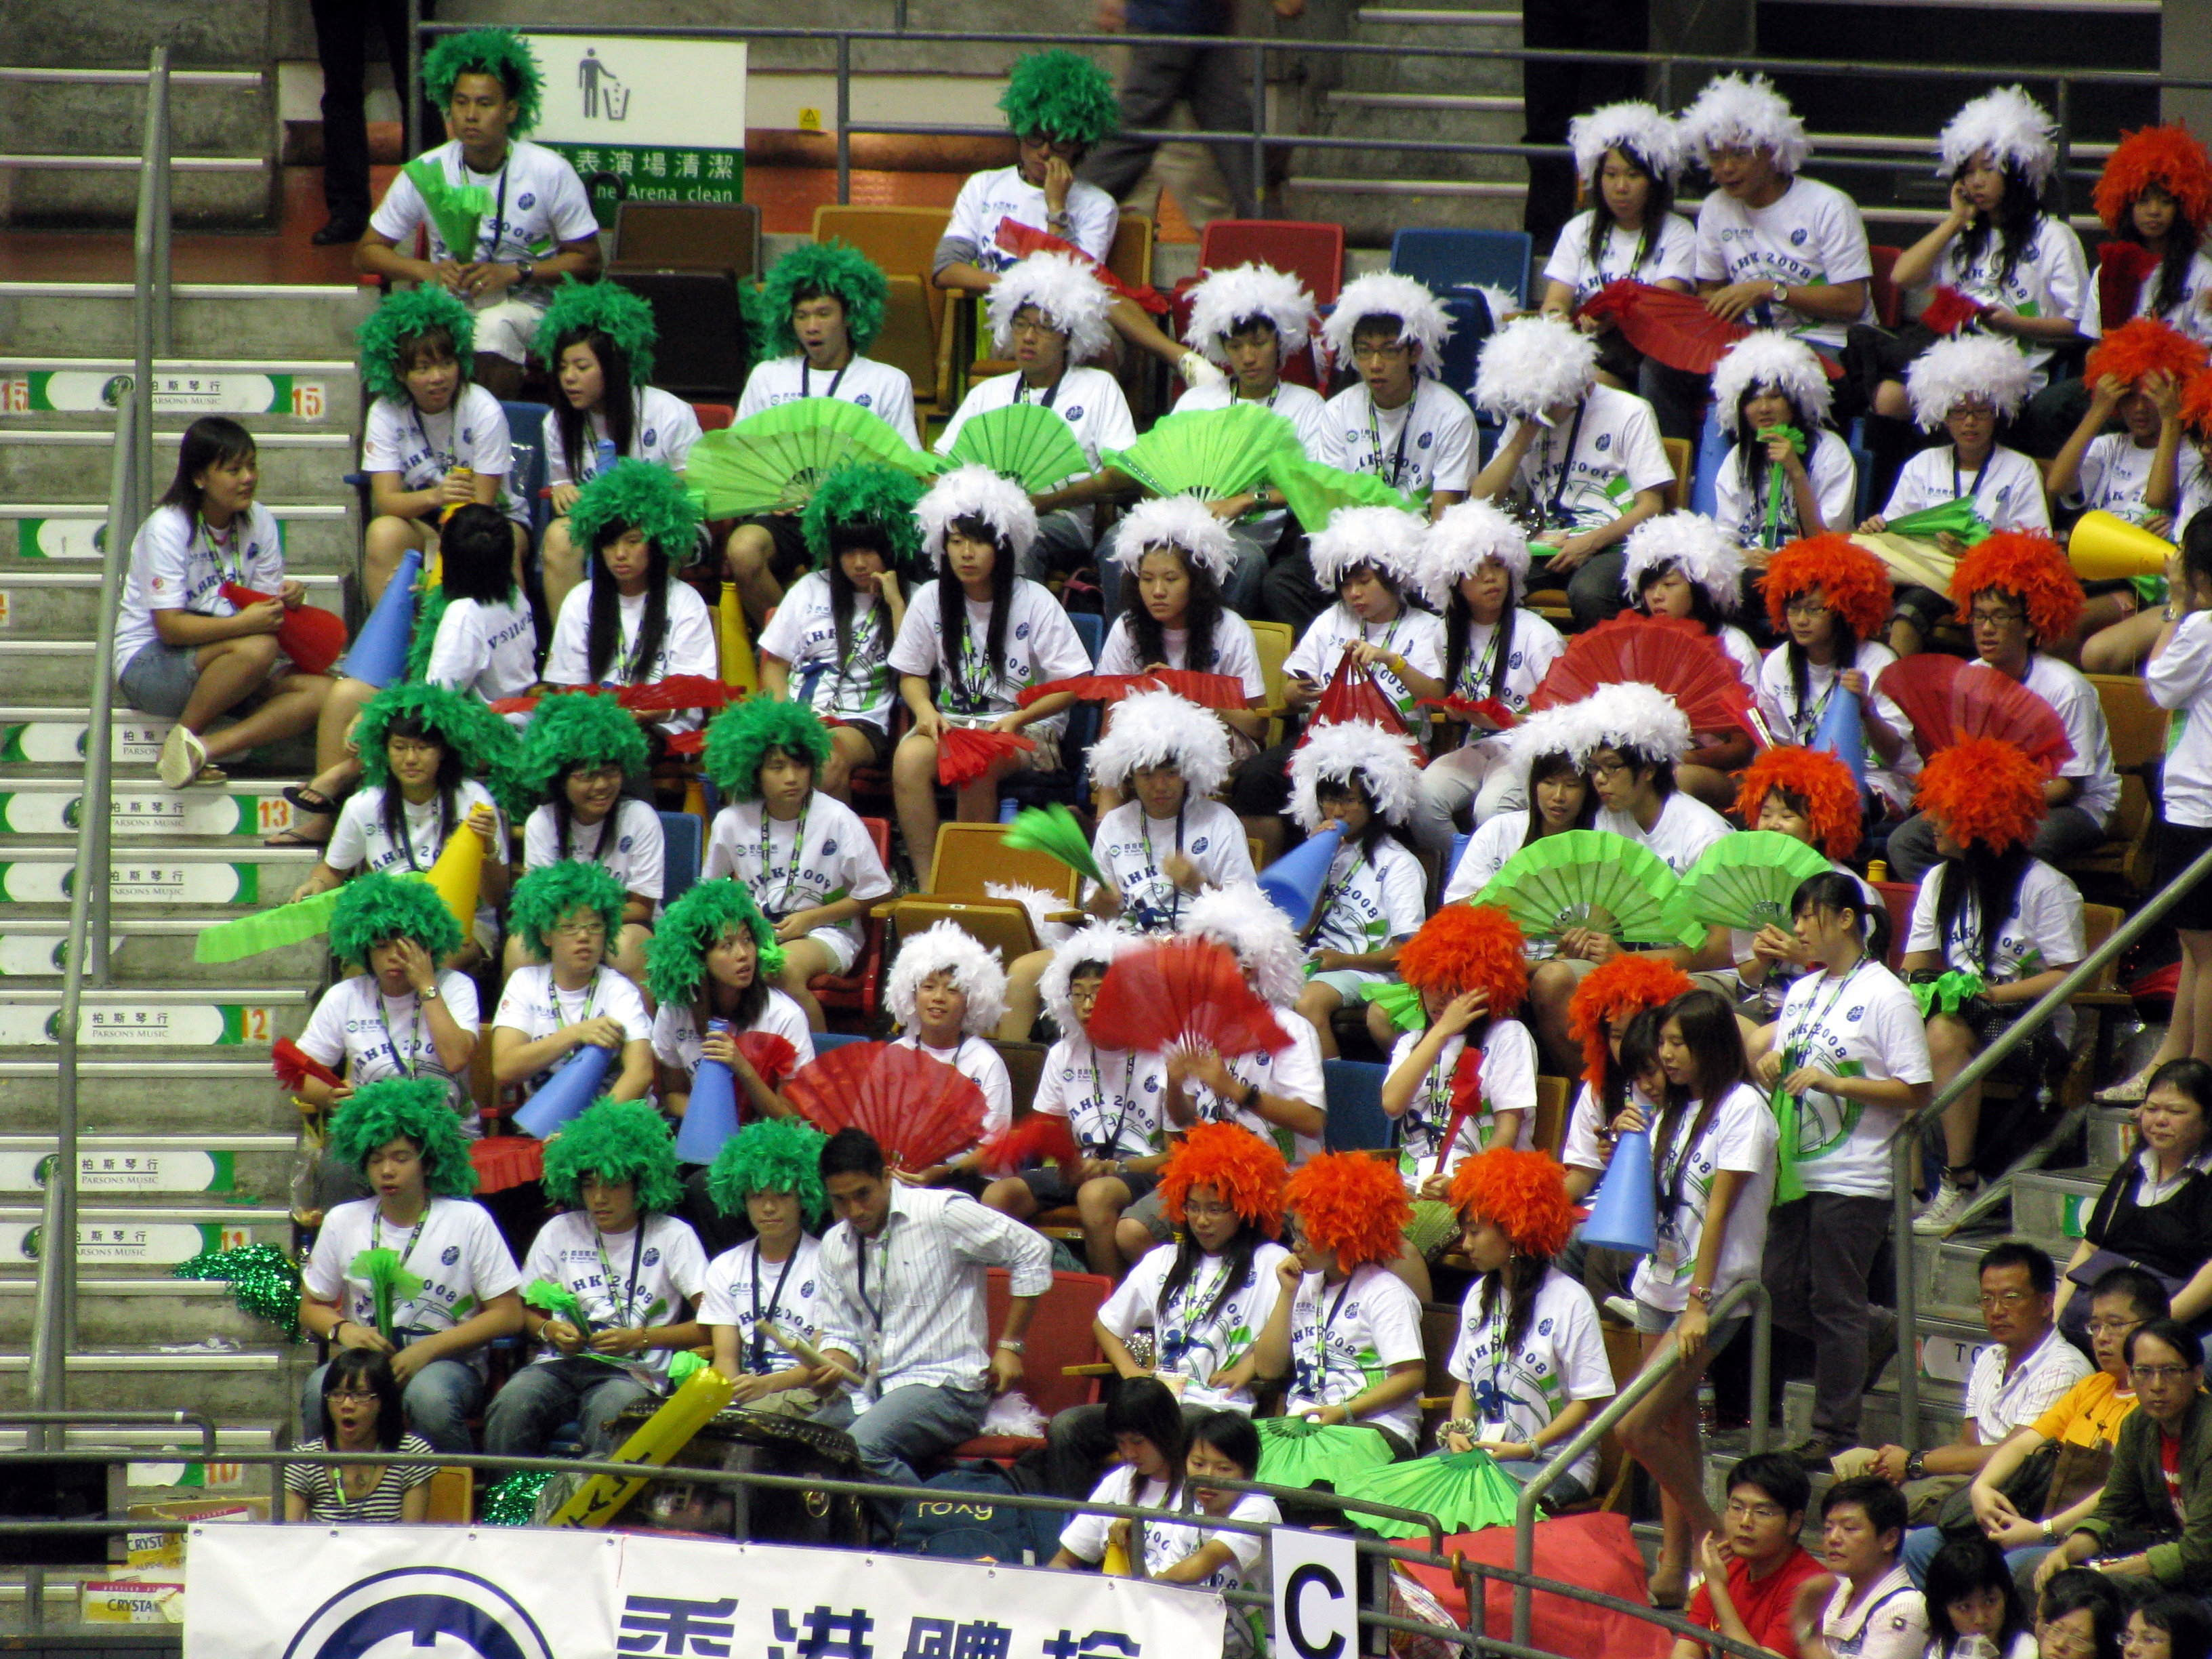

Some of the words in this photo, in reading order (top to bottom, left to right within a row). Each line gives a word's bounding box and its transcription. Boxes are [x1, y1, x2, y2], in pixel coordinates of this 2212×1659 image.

[628, 184, 677, 201] Arena
[689, 186, 733, 203] clean
[1765, 253, 1811, 279] 2008
[1, 382, 28, 411] 15
[293, 388, 322, 416] 15
[124, 731, 171, 741] 柏斯
[154, 819, 184, 827] MUSIC
[259, 800, 291, 827] 13
[153, 888, 184, 896] MUSIC
[1342, 886, 1378, 919] 2008
[92, 1012, 169, 1024] 柏斯琴行
[242, 1009, 268, 1040] 12
[92, 1029, 134, 1038] PARSONS
[138, 1029, 169, 1038] MUSIC
[1113, 1095, 1154, 1130] 2008
[82, 1158, 159, 1170] 柏斯琴行
[82, 1176, 124, 1185] PARSONS
[128, 1176, 159, 1185] MUSIC
[77, 1248, 112, 1256] ARSONS
[116, 1248, 146, 1256] MUSIC
[1285, 1563, 1346, 1659] C
